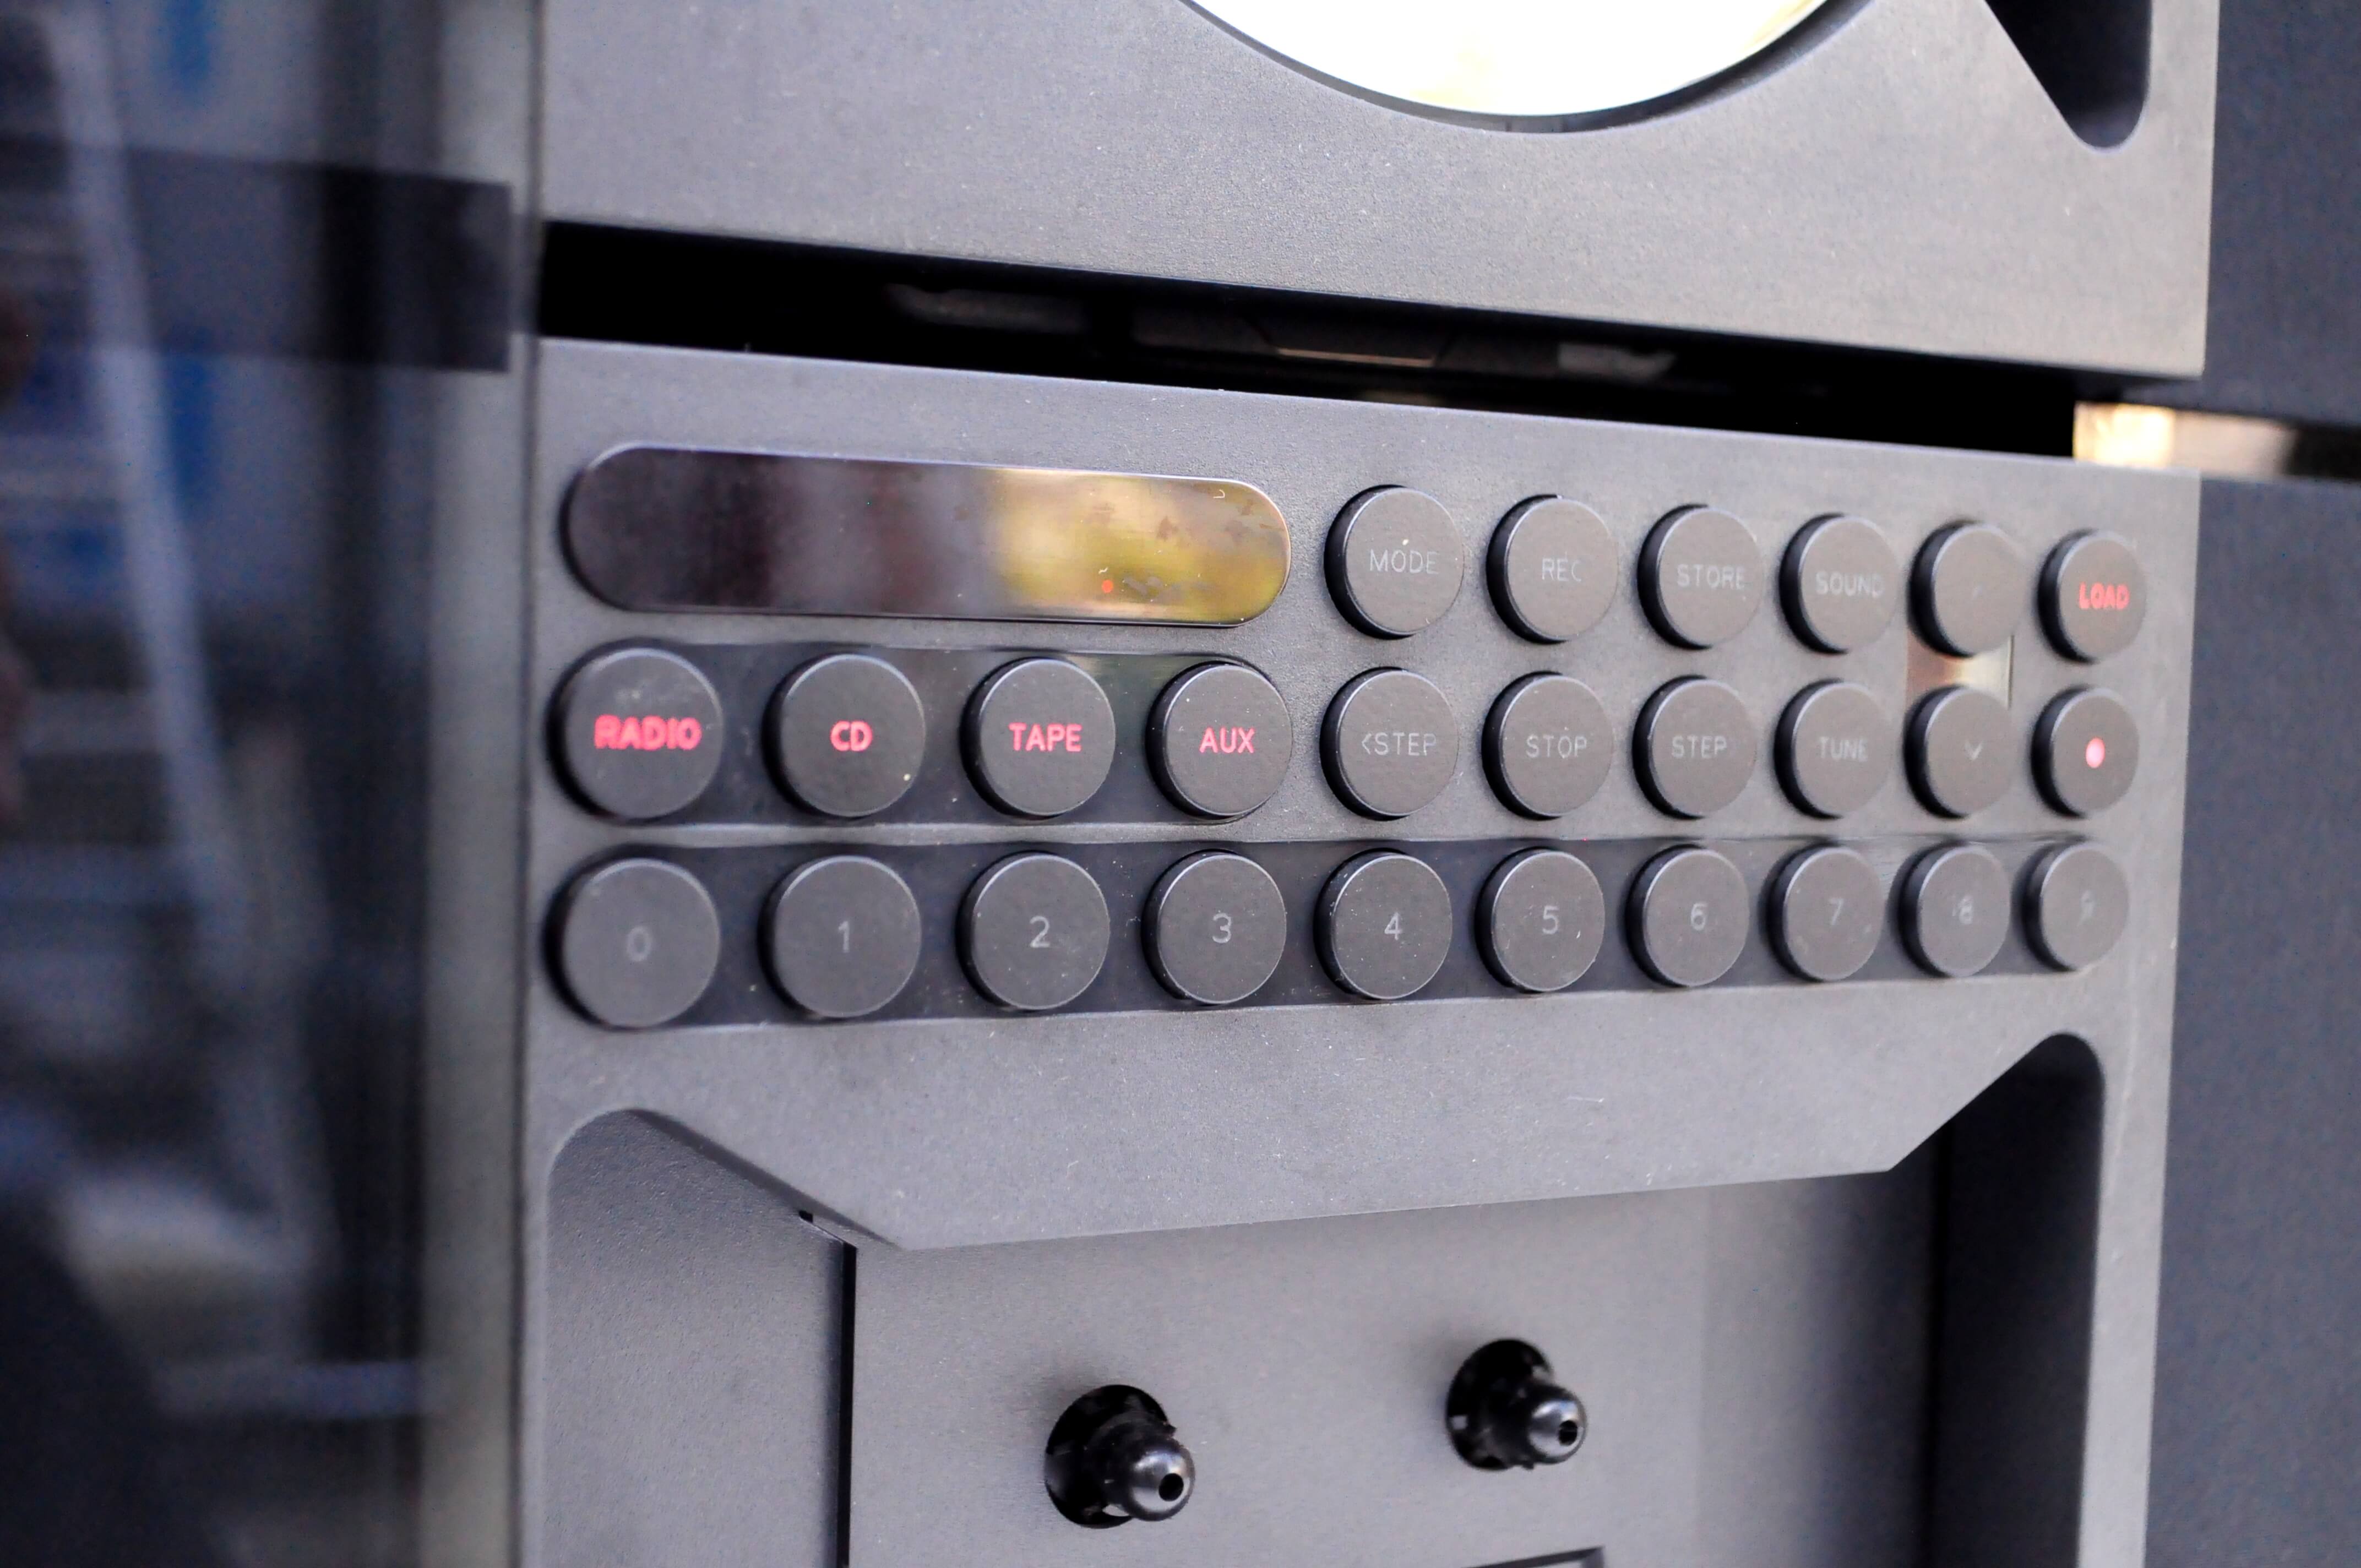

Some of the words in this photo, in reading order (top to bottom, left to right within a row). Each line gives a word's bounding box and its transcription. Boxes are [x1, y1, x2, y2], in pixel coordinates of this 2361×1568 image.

[1369, 551, 1439, 575] MODE
[1542, 557, 1582, 583] REC
[1676, 564, 1745, 590] STORE
[1815, 571, 1884, 598] SOUND
[2079, 582, 2130, 609] LOAD
[594, 715, 703, 750] RADIO
[830, 720, 873, 752] CD
[1009, 722, 1082, 752] TAPE
[1199, 727, 1255, 754] AUX
[1525, 734, 1587, 759] STOP
[1818, 736, 1868, 762] TUNE
[1542, 905, 1560, 936] 5
[1689, 902, 1709, 931] 6
[1828, 897, 1845, 926] 7
[837, 920, 851, 954] 1
[1030, 915, 1051, 948] 2
[1211, 912, 1232, 944] 3
[1383, 912, 1403, 940] 4
